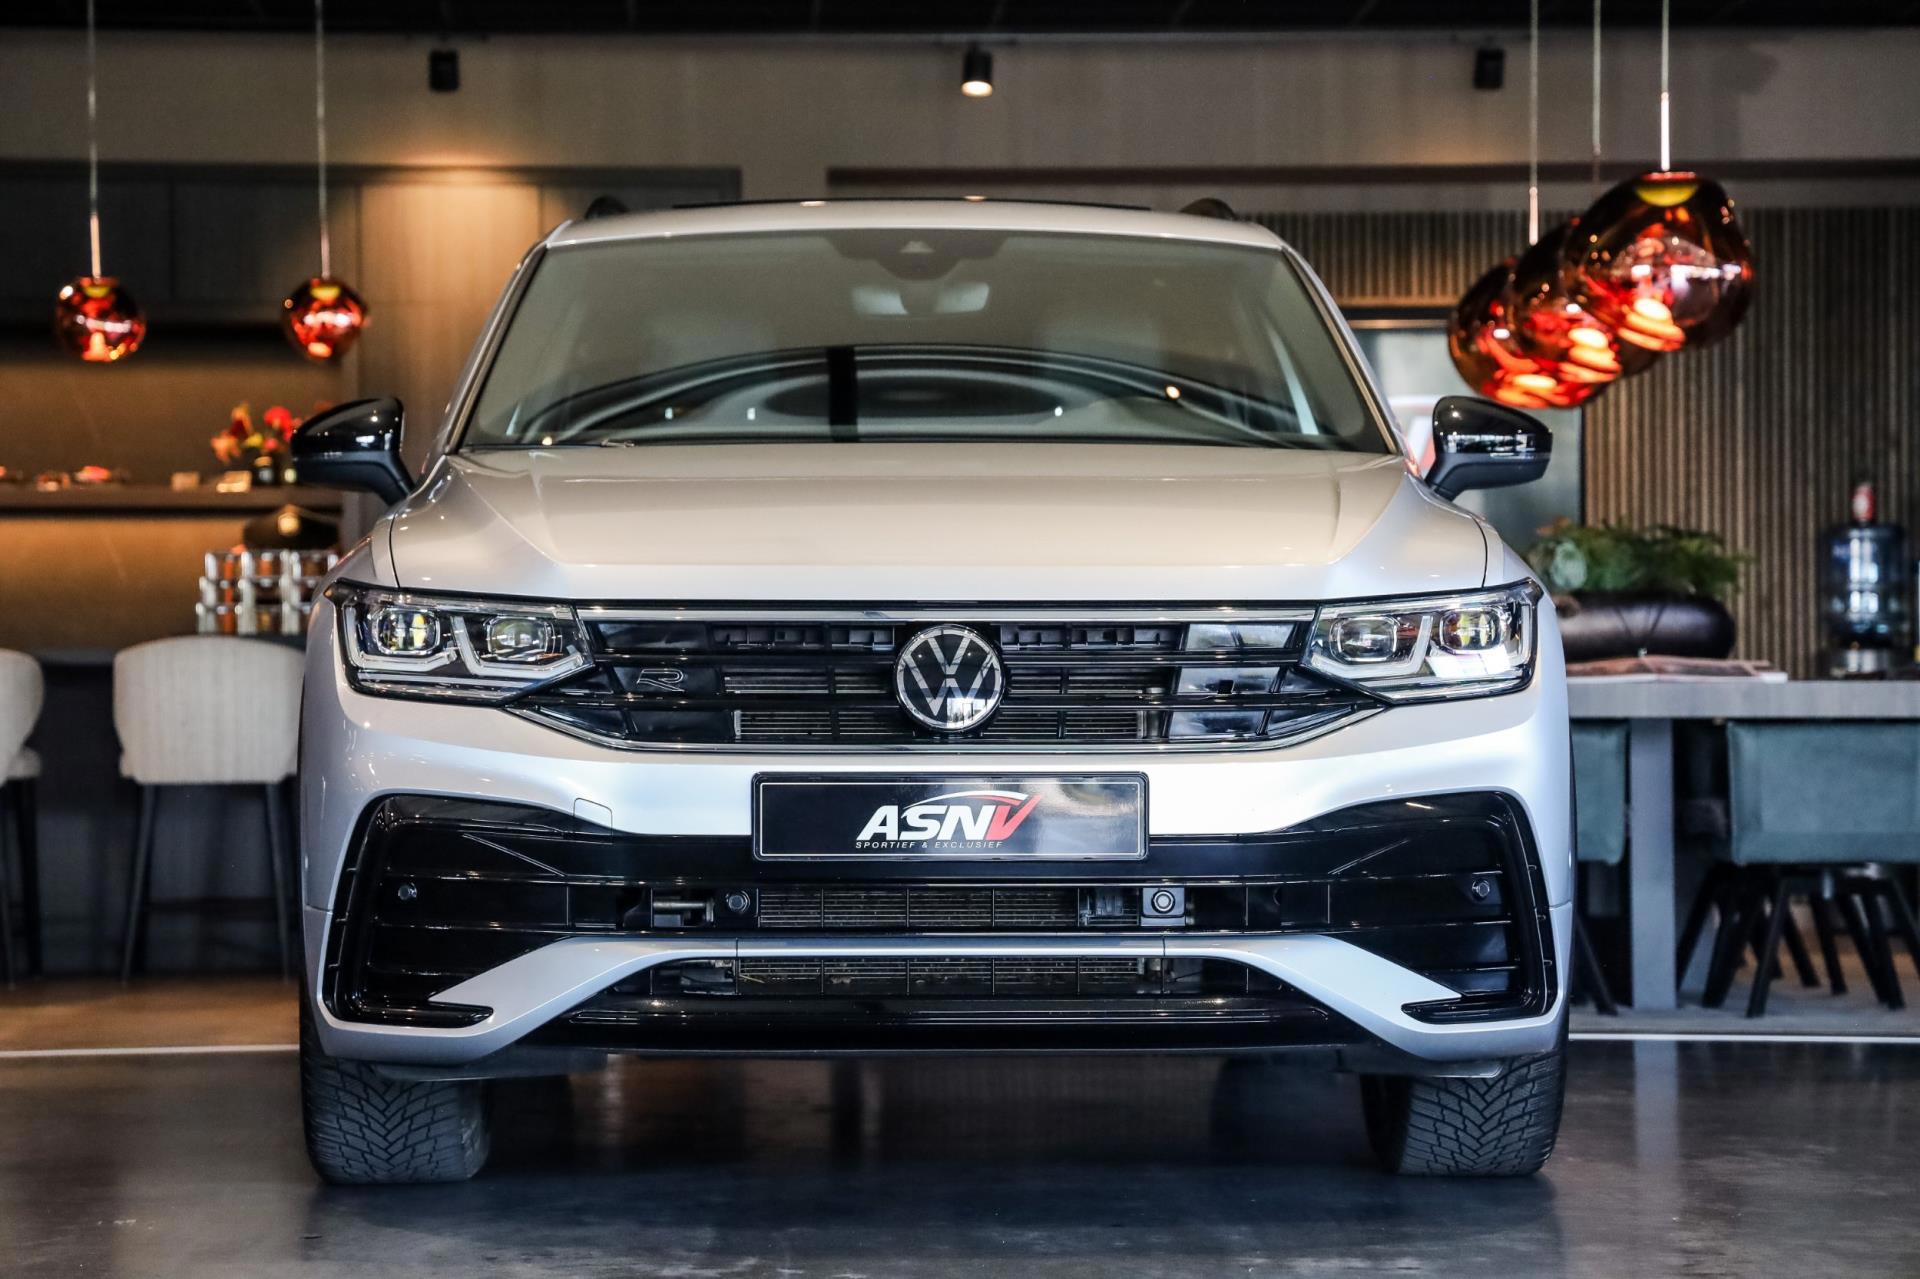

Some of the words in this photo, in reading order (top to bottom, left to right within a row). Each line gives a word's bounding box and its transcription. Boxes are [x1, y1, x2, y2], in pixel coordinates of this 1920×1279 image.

[636, 668, 685, 692] R
[855, 841, 917, 849] SPORTIEF
[921, 841, 929, 849] &
[935, 841, 1004, 849] EXCLUSIEF
